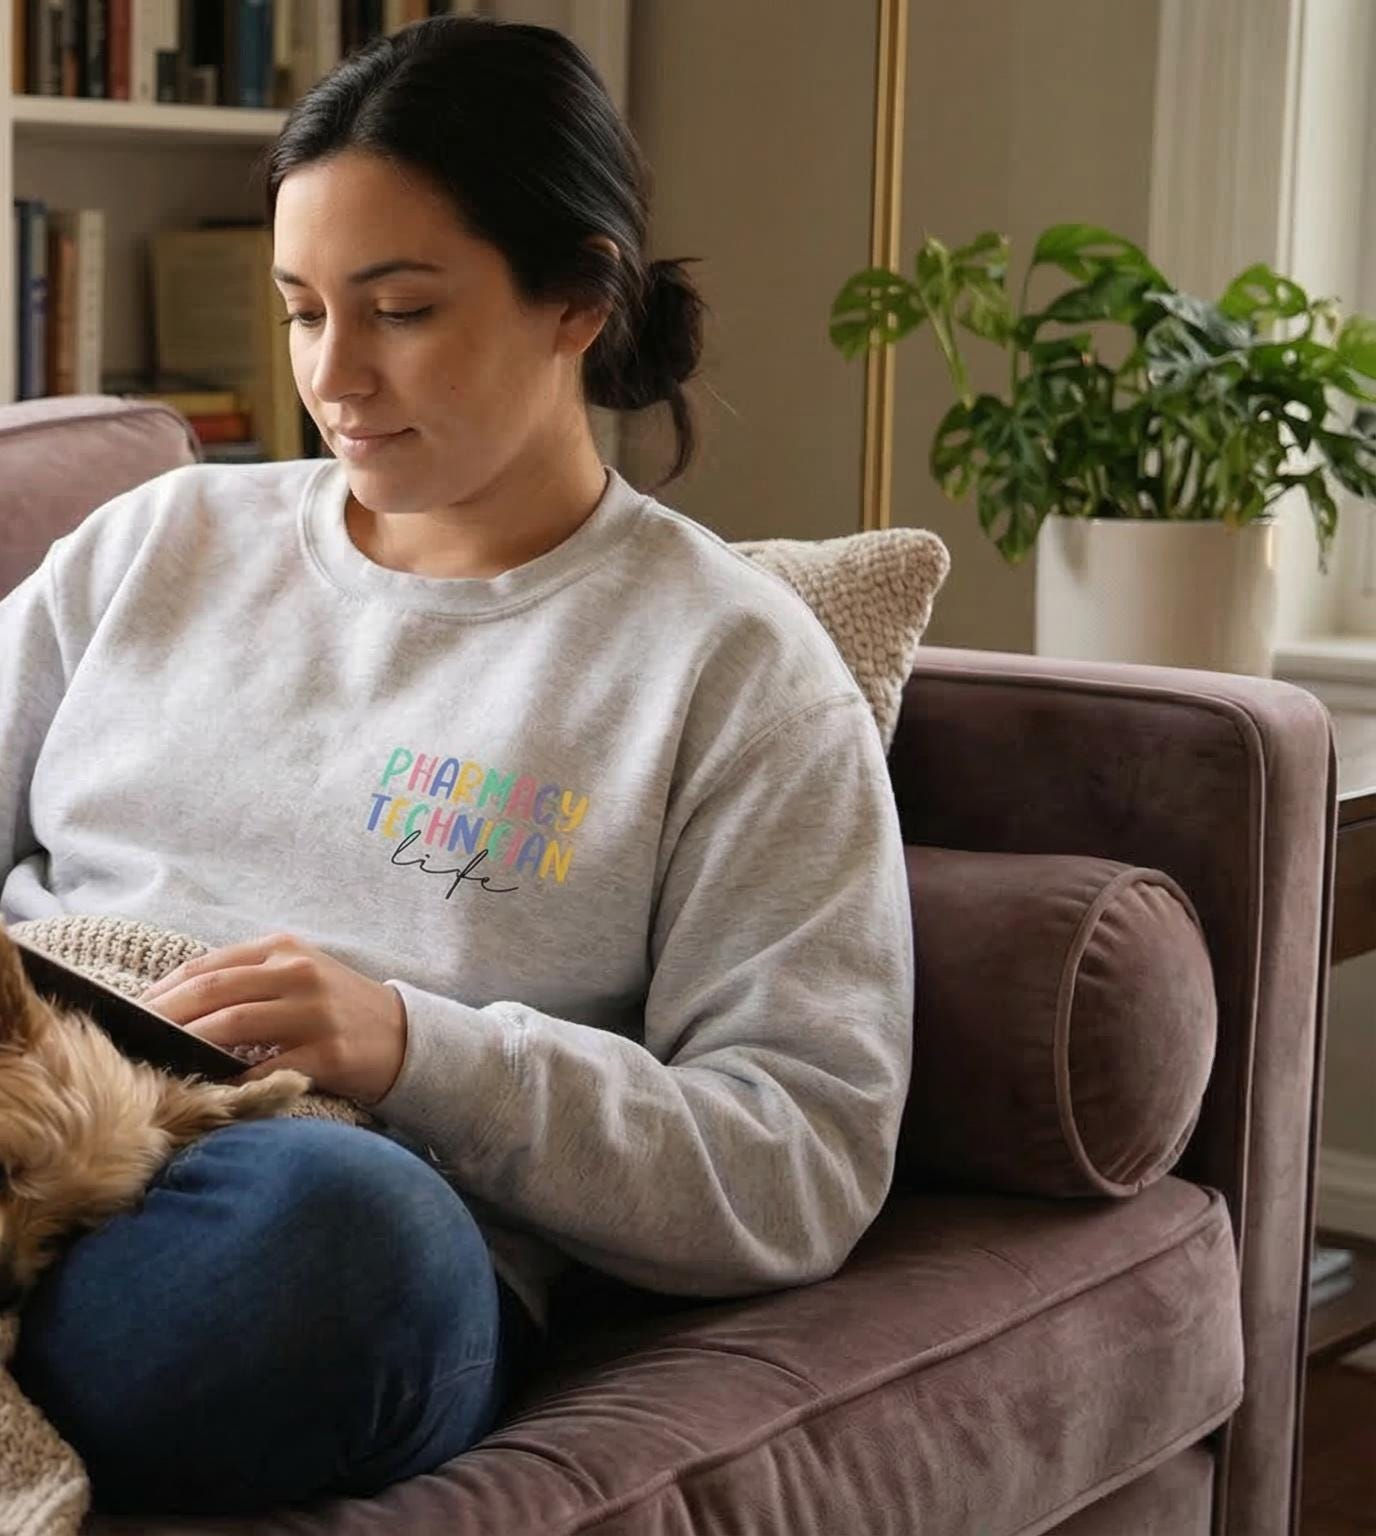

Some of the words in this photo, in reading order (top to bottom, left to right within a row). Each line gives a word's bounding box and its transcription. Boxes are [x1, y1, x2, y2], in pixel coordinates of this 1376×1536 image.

[380, 747, 589, 832] PHARMACY
[367, 793, 572, 884] TECHNICIAN
[391, 829, 519, 899] life
